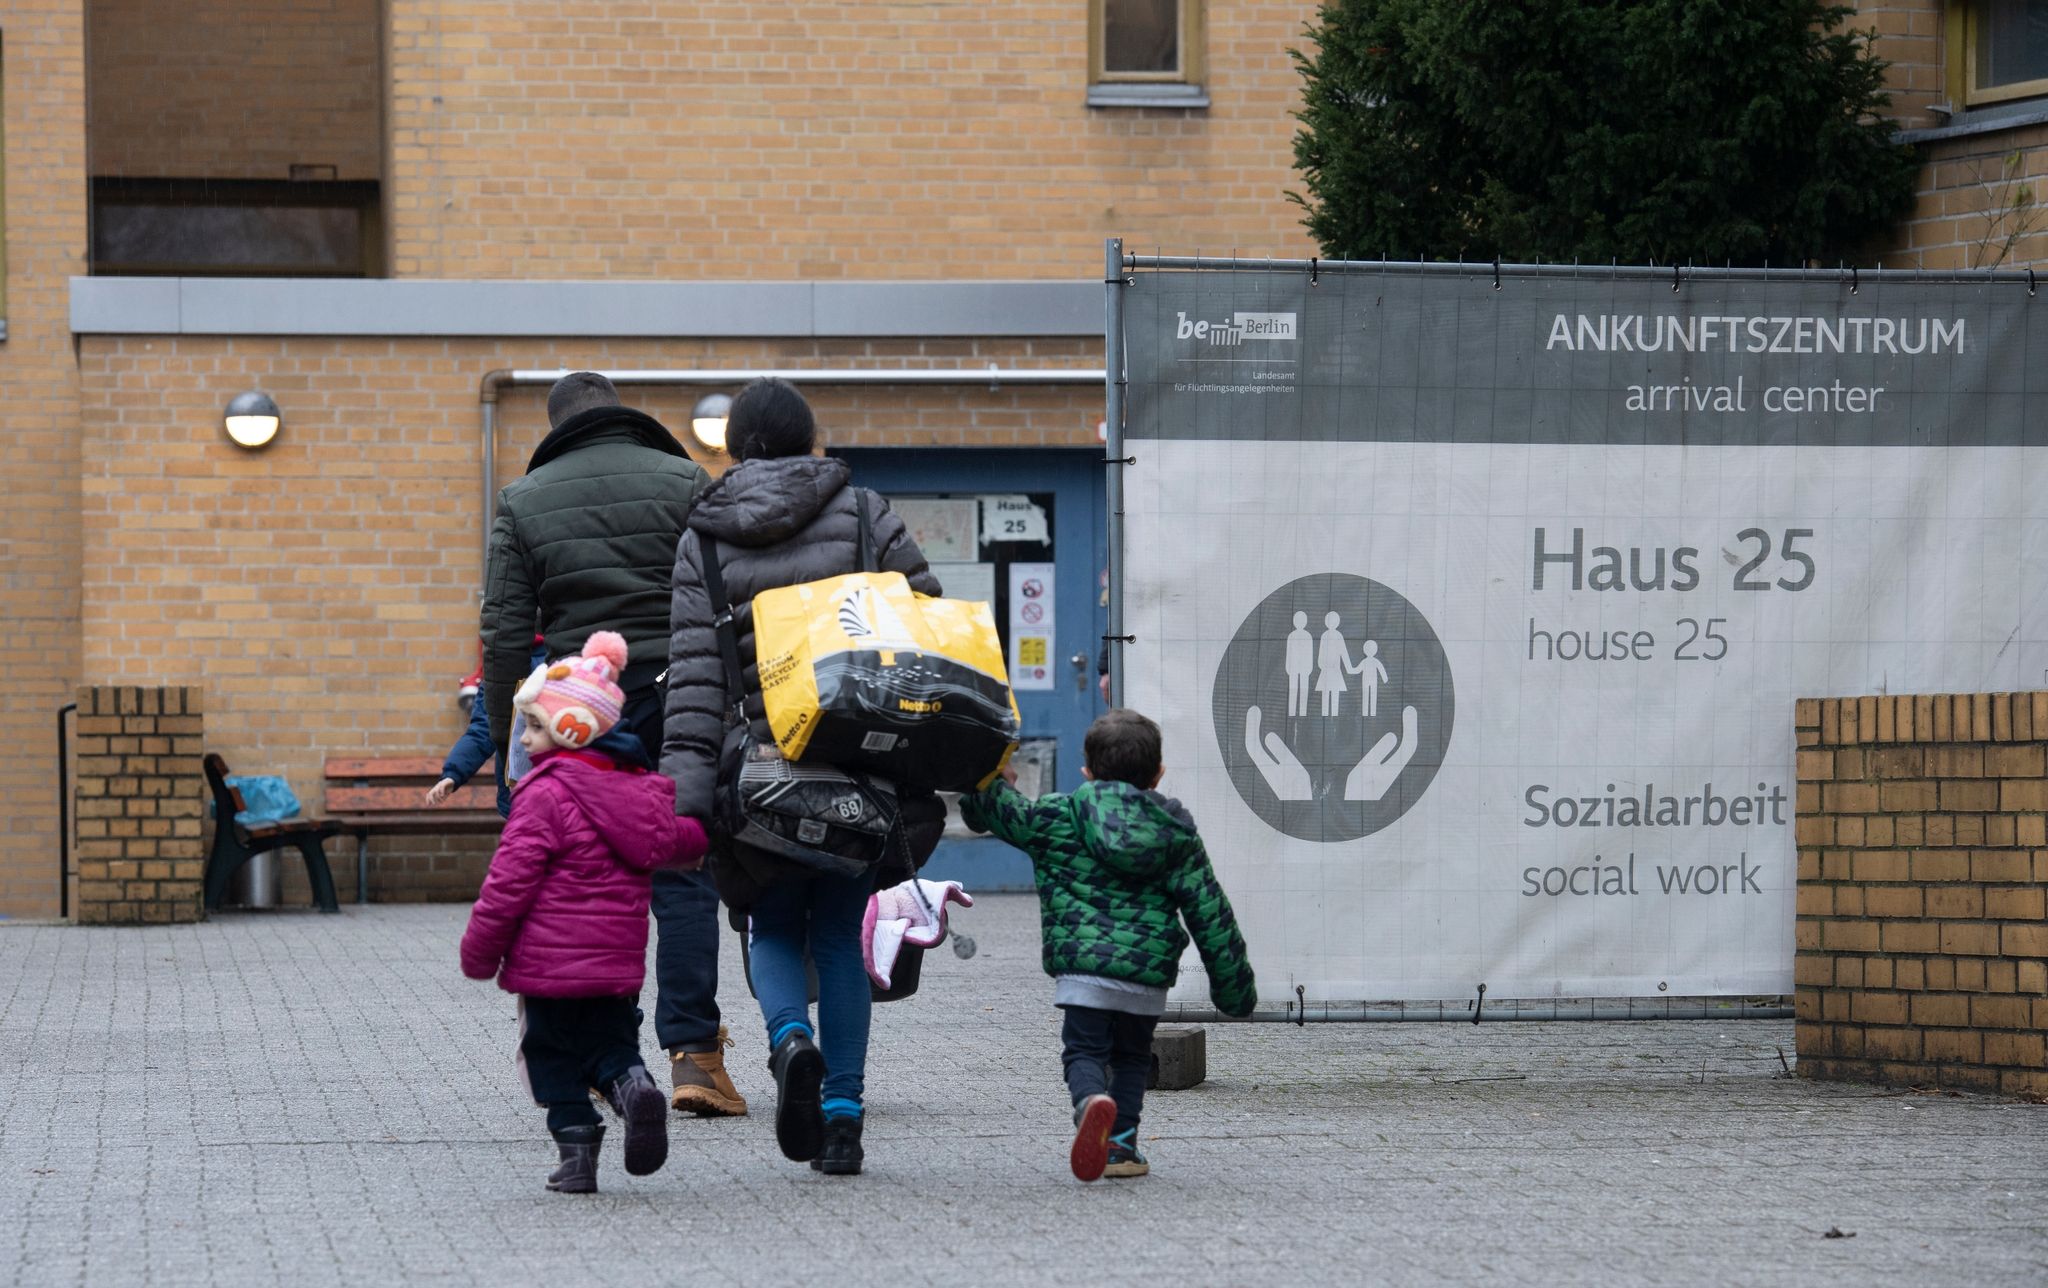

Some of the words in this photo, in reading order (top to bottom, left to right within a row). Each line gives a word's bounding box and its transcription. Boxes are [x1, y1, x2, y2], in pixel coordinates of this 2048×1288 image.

[1177, 311, 1209, 339] be
[1245, 318, 1290, 334] Berlin
[1545, 313, 1965, 354] ANKUNFTSZENTRUM
[1174, 383, 1186, 392] für
[1187, 383, 1295, 394] Flüchtlingsangelegenheiten
[1252, 371, 1295, 380] Landesamt
[1625, 375, 1746, 412] arrival
[1762, 379, 1885, 413] center
[997, 500, 1032, 511] Haus
[1004, 519, 1026, 533] 25
[1532, 527, 1700, 592] Haus
[1732, 527, 1817, 592] 25
[1528, 617, 1655, 661] house
[1673, 617, 1729, 661] 25
[763, 673, 791, 691] LASTIC
[899, 698, 931, 712] Netto
[780, 722, 802, 748] Netto
[839, 800, 860, 818] 69
[1523, 782, 1788, 828] Sozialarbeit
[1521, 852, 1639, 896] social
[1655, 852, 1763, 895] work
